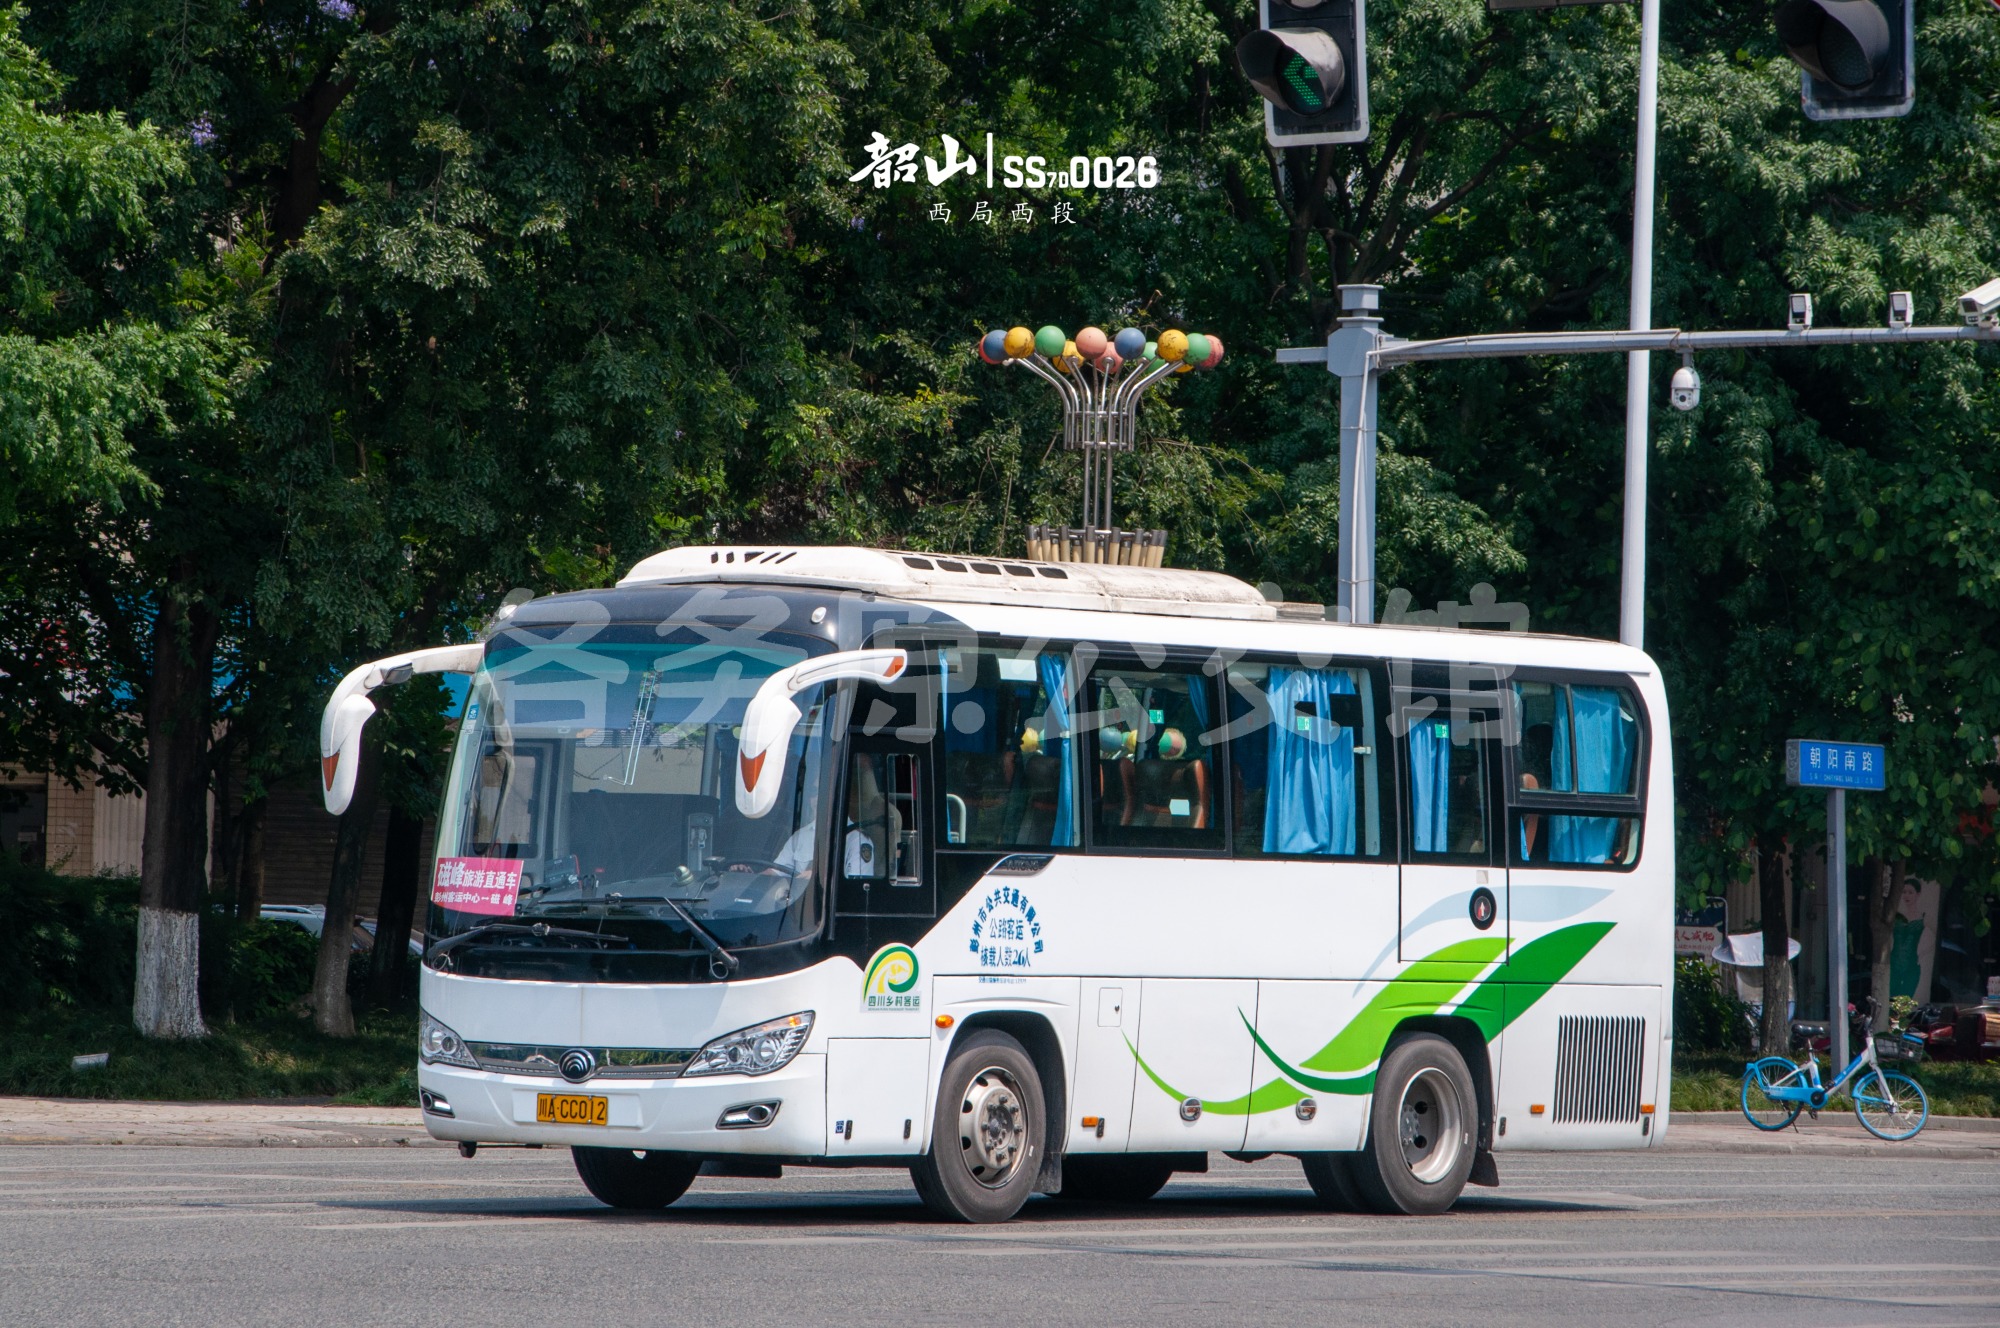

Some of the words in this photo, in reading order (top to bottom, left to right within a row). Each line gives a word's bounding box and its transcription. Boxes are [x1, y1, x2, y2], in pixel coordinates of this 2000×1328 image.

[1810, 746, 1874, 772] 朝阳南路
[437, 861, 517, 890] 磁峰旅游直通车
[989, 917, 1024, 940] 公路客运
[868, 995, 920, 1007] 四川乡村客运
